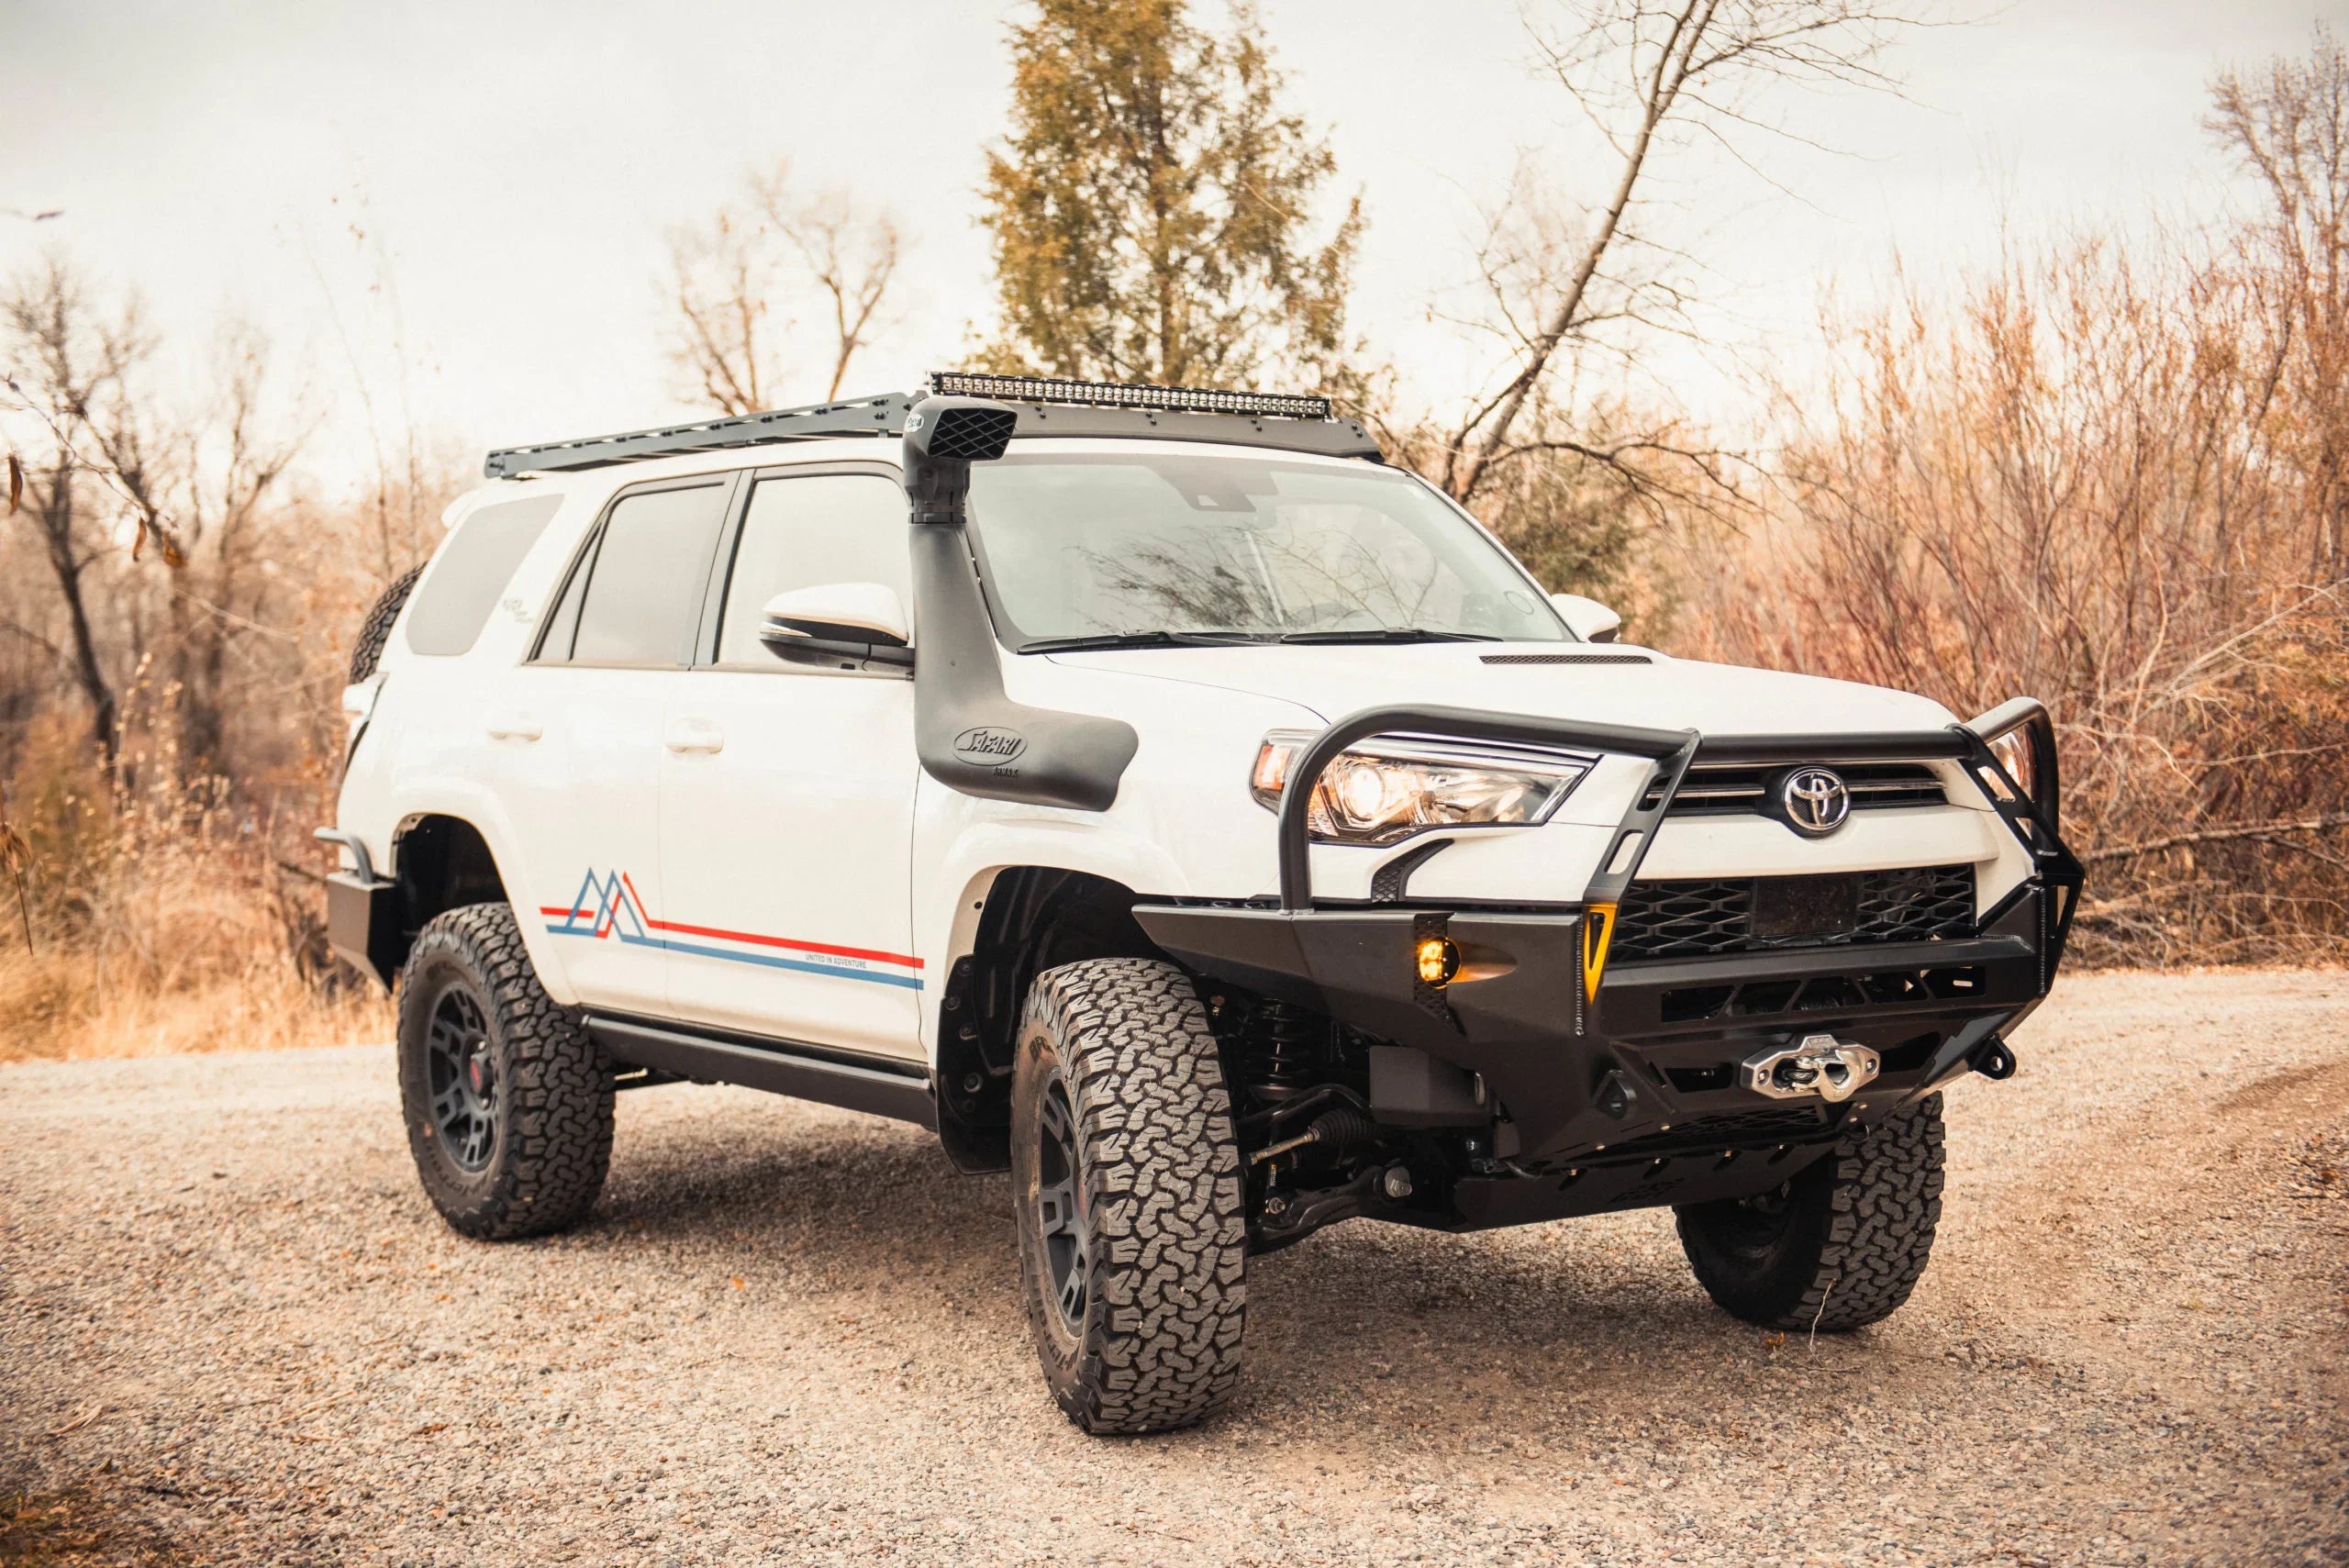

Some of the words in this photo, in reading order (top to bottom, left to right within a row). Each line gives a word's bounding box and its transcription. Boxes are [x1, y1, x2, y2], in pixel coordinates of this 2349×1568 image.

[957, 730, 1022, 756] SAFARI
[806, 953, 826, 962] UNITED
[827, 955, 833, 964] IN
[834, 958, 867, 969] ADVENTURE
